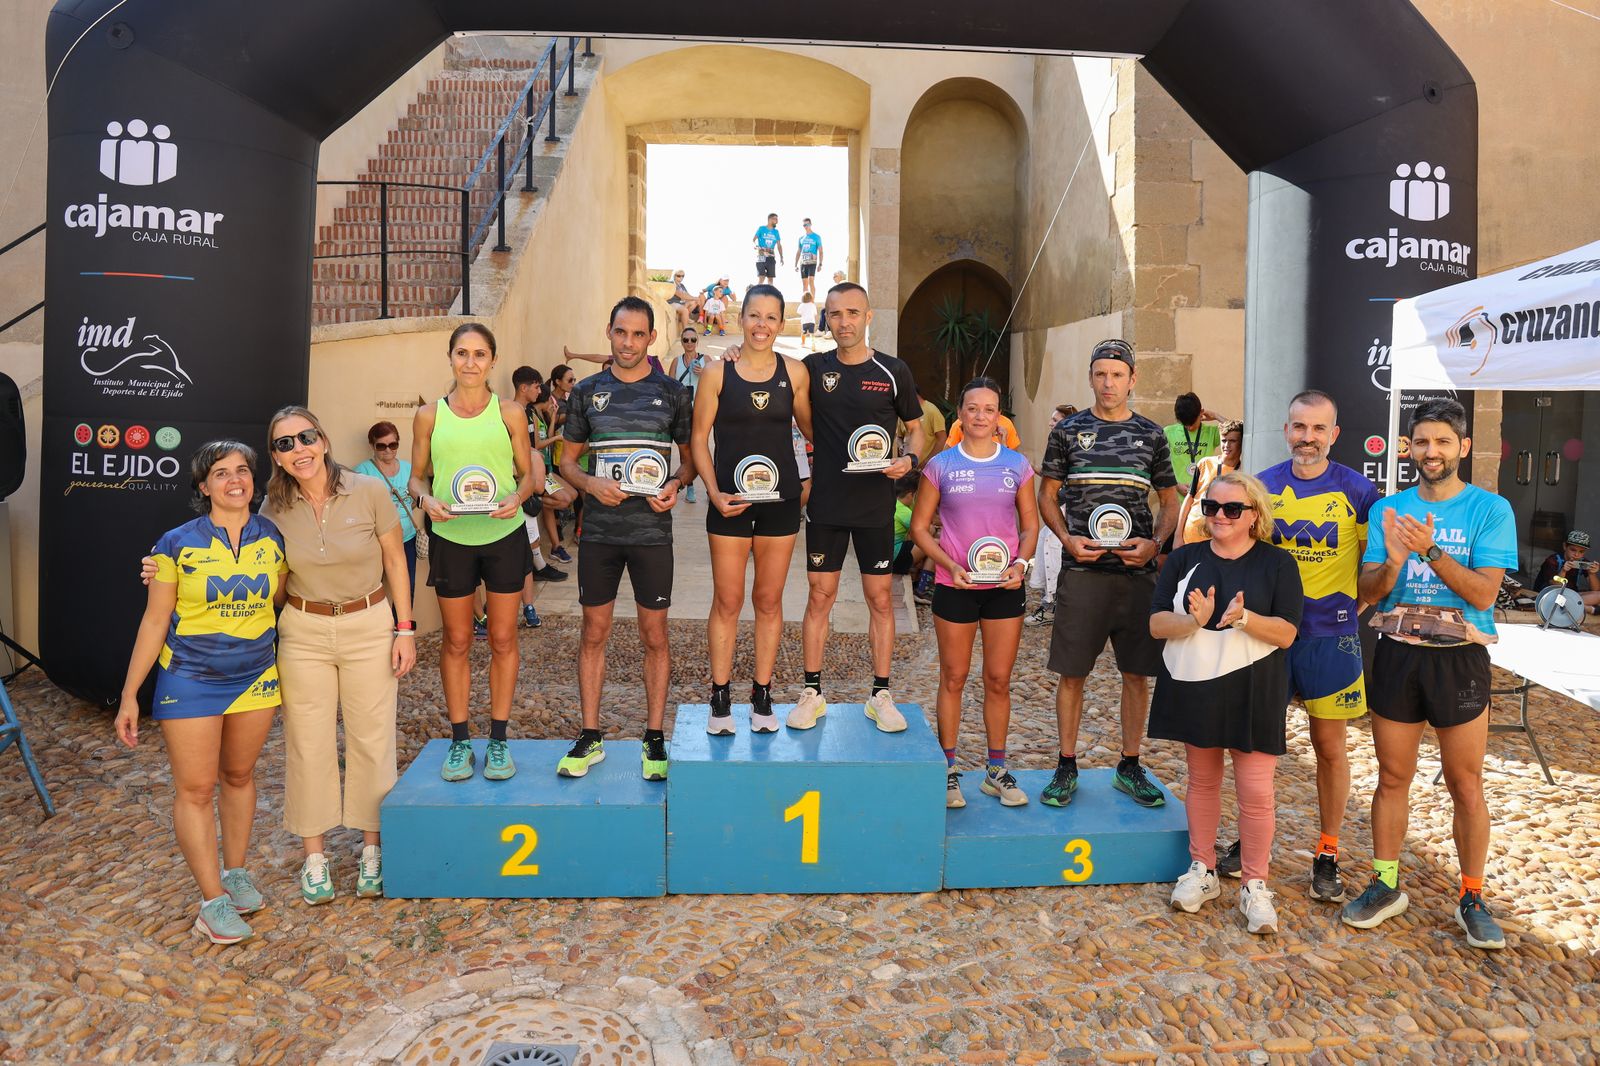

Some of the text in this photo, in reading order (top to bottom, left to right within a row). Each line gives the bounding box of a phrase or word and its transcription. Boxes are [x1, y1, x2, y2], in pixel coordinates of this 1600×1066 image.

[64, 193, 224, 238] cajamar
[132, 231, 219, 249] CAJA RURAL
[1345, 228, 1471, 268] cajamar
[1420, 261, 1469, 279] CAJA RURAL
[77, 316, 137, 348] imd
[1367, 338, 1392, 366] im
[93, 378, 124, 386] Instituto
[128, 379, 170, 390] Municipal
[102, 387, 135, 396] Deportes
[149, 389, 159, 397] El
[160, 389, 184, 398] Ejido
[72, 452, 180, 478] EL EJIDO
[611, 464, 623, 482] 6
[1363, 462, 1387, 482] EL
[64, 476, 178, 496] gourmet QUALITY
[206, 603, 246, 611] MUEBLES
[232, 610, 256, 618] EJIDO
[783, 790, 821, 864] 1
[500, 823, 539, 877] 2
[1062, 838, 1094, 883] 3
